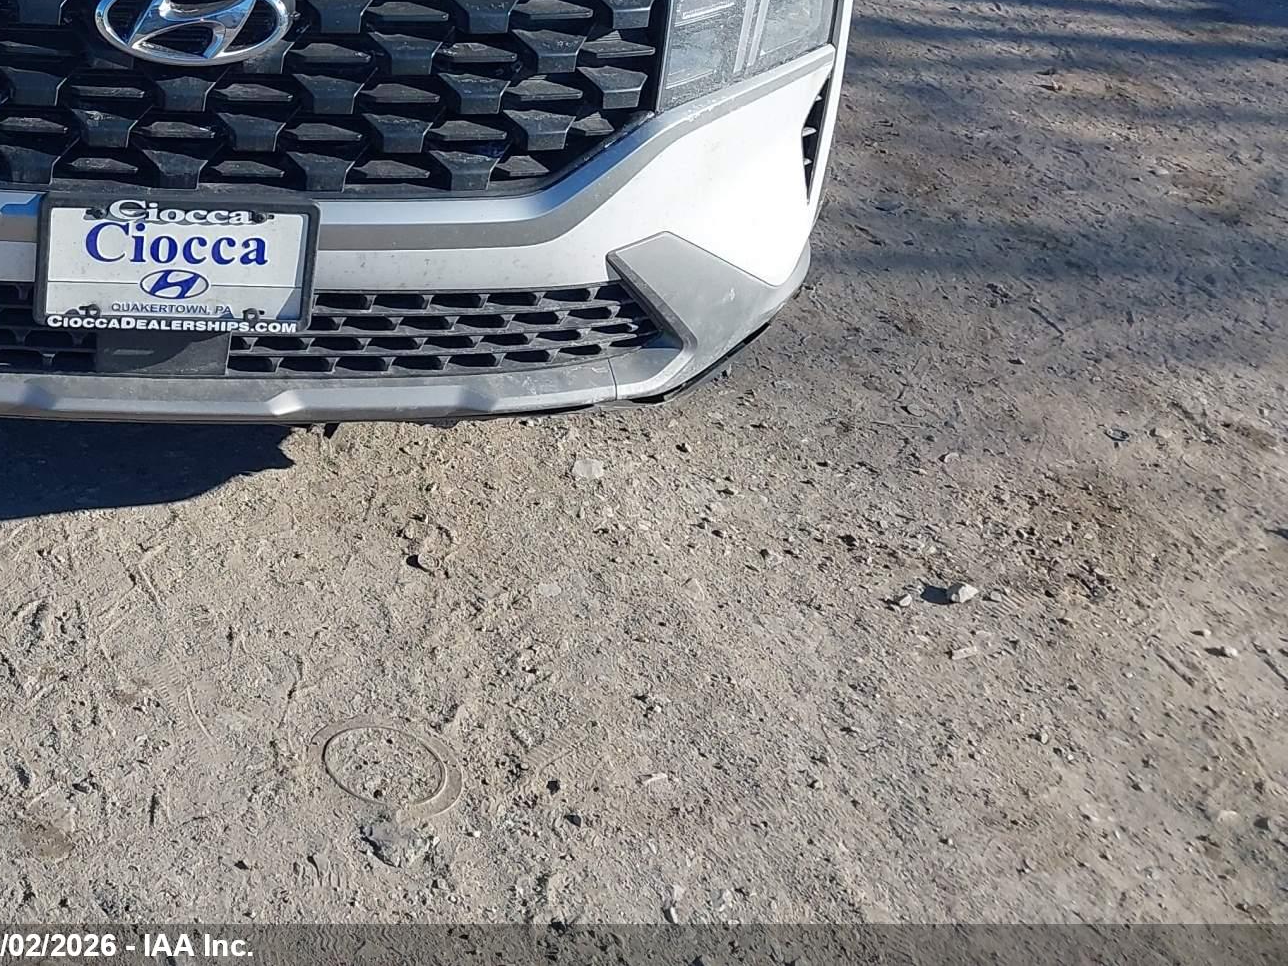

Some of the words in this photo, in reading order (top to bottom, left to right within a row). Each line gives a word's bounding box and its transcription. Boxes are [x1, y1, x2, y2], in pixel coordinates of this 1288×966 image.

[109, 199, 253, 224] Ciocca
[85, 221, 269, 266] Ciocca
[111, 302, 211, 315] QUAKERTOWN,
[215, 305, 232, 314] PA
